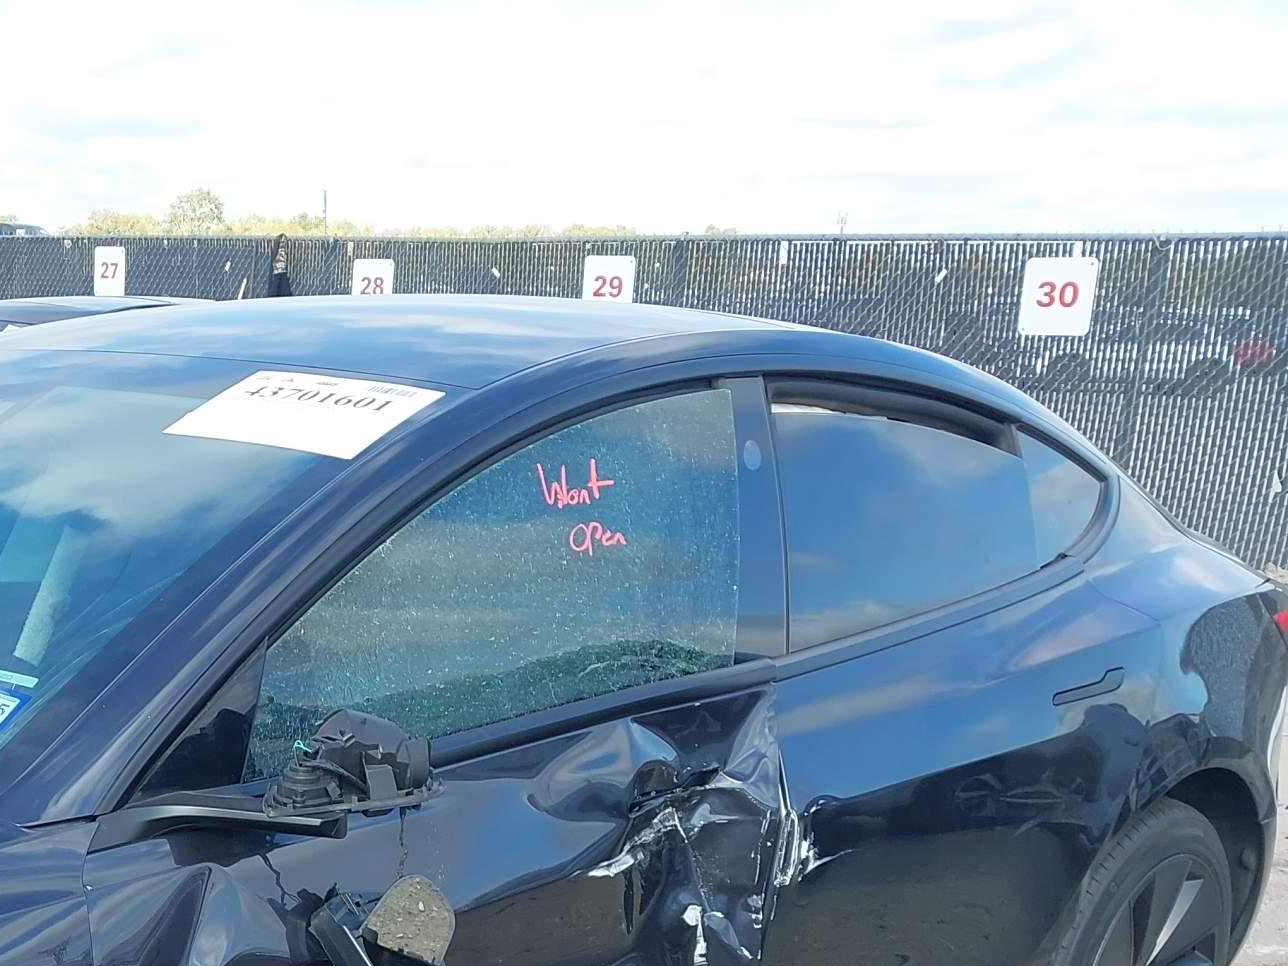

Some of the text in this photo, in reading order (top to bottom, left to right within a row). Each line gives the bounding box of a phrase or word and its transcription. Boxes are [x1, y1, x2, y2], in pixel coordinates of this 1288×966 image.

[100, 261, 119, 280] 27
[359, 276, 385, 295] 28
[592, 275, 624, 298] 29
[1035, 281, 1080, 308] 30
[244, 384, 394, 412] 43701601
